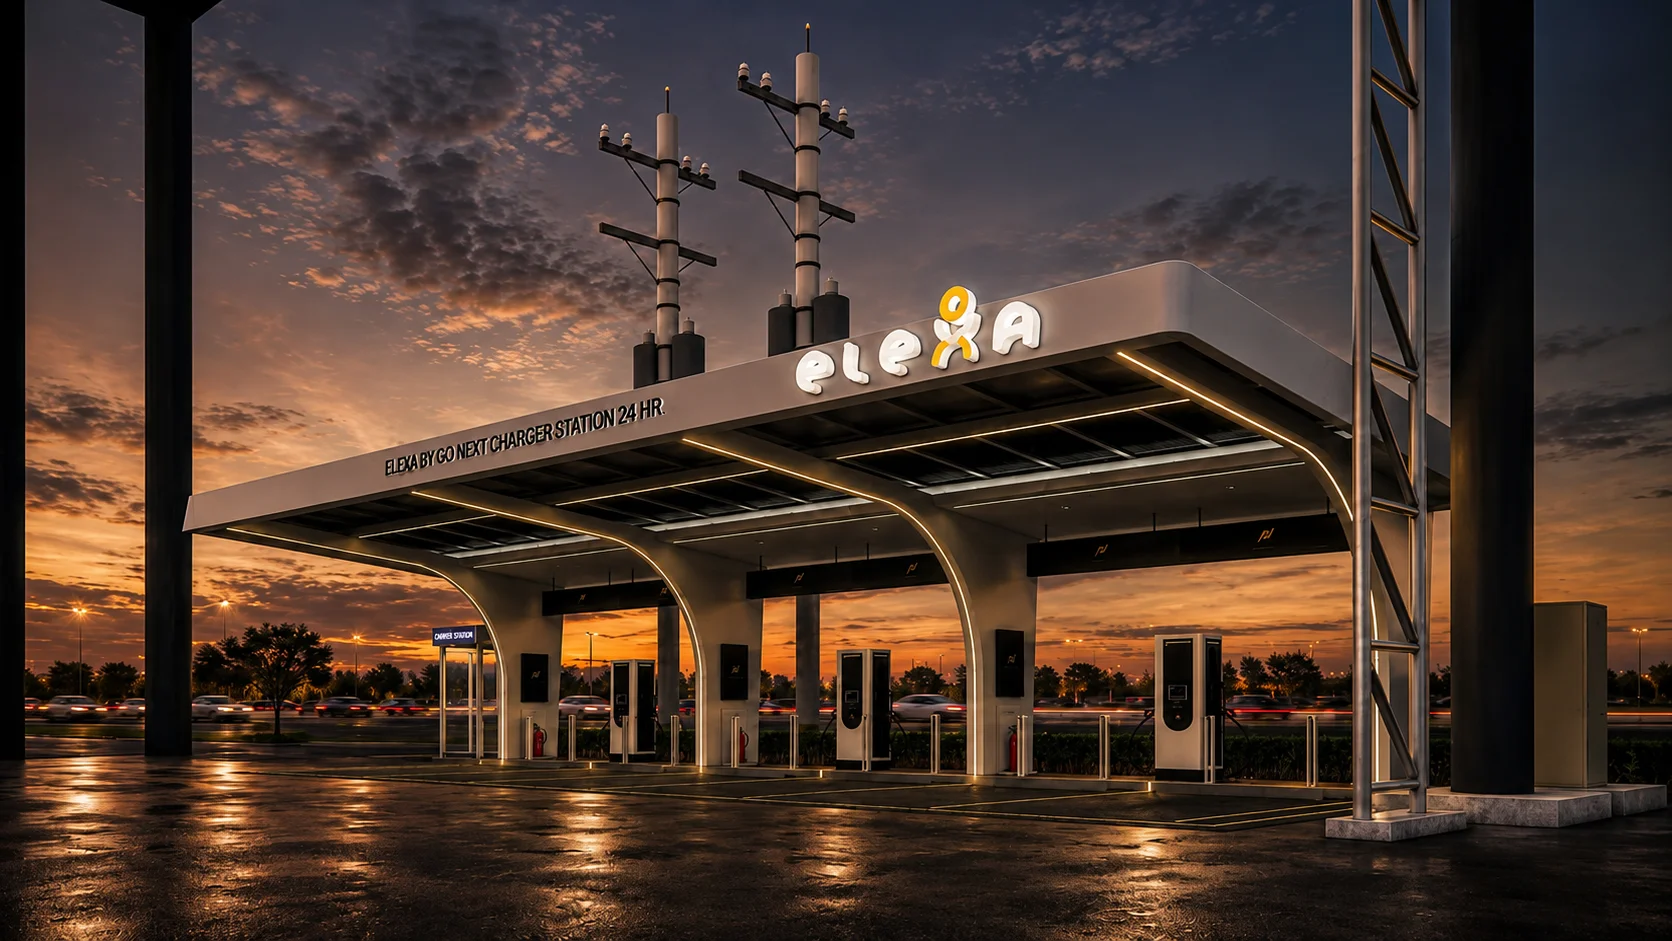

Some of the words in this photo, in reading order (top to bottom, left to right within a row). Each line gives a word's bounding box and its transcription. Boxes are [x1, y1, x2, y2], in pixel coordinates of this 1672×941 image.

[385, 454, 419, 476] ELEXA
[420, 450, 436, 468] BY
[437, 446, 455, 464] GO
[457, 438, 488, 460] NEXT
[490, 424, 553, 453] CHARGER
[555, 408, 615, 438] STATION
[617, 405, 637, 424] 24
